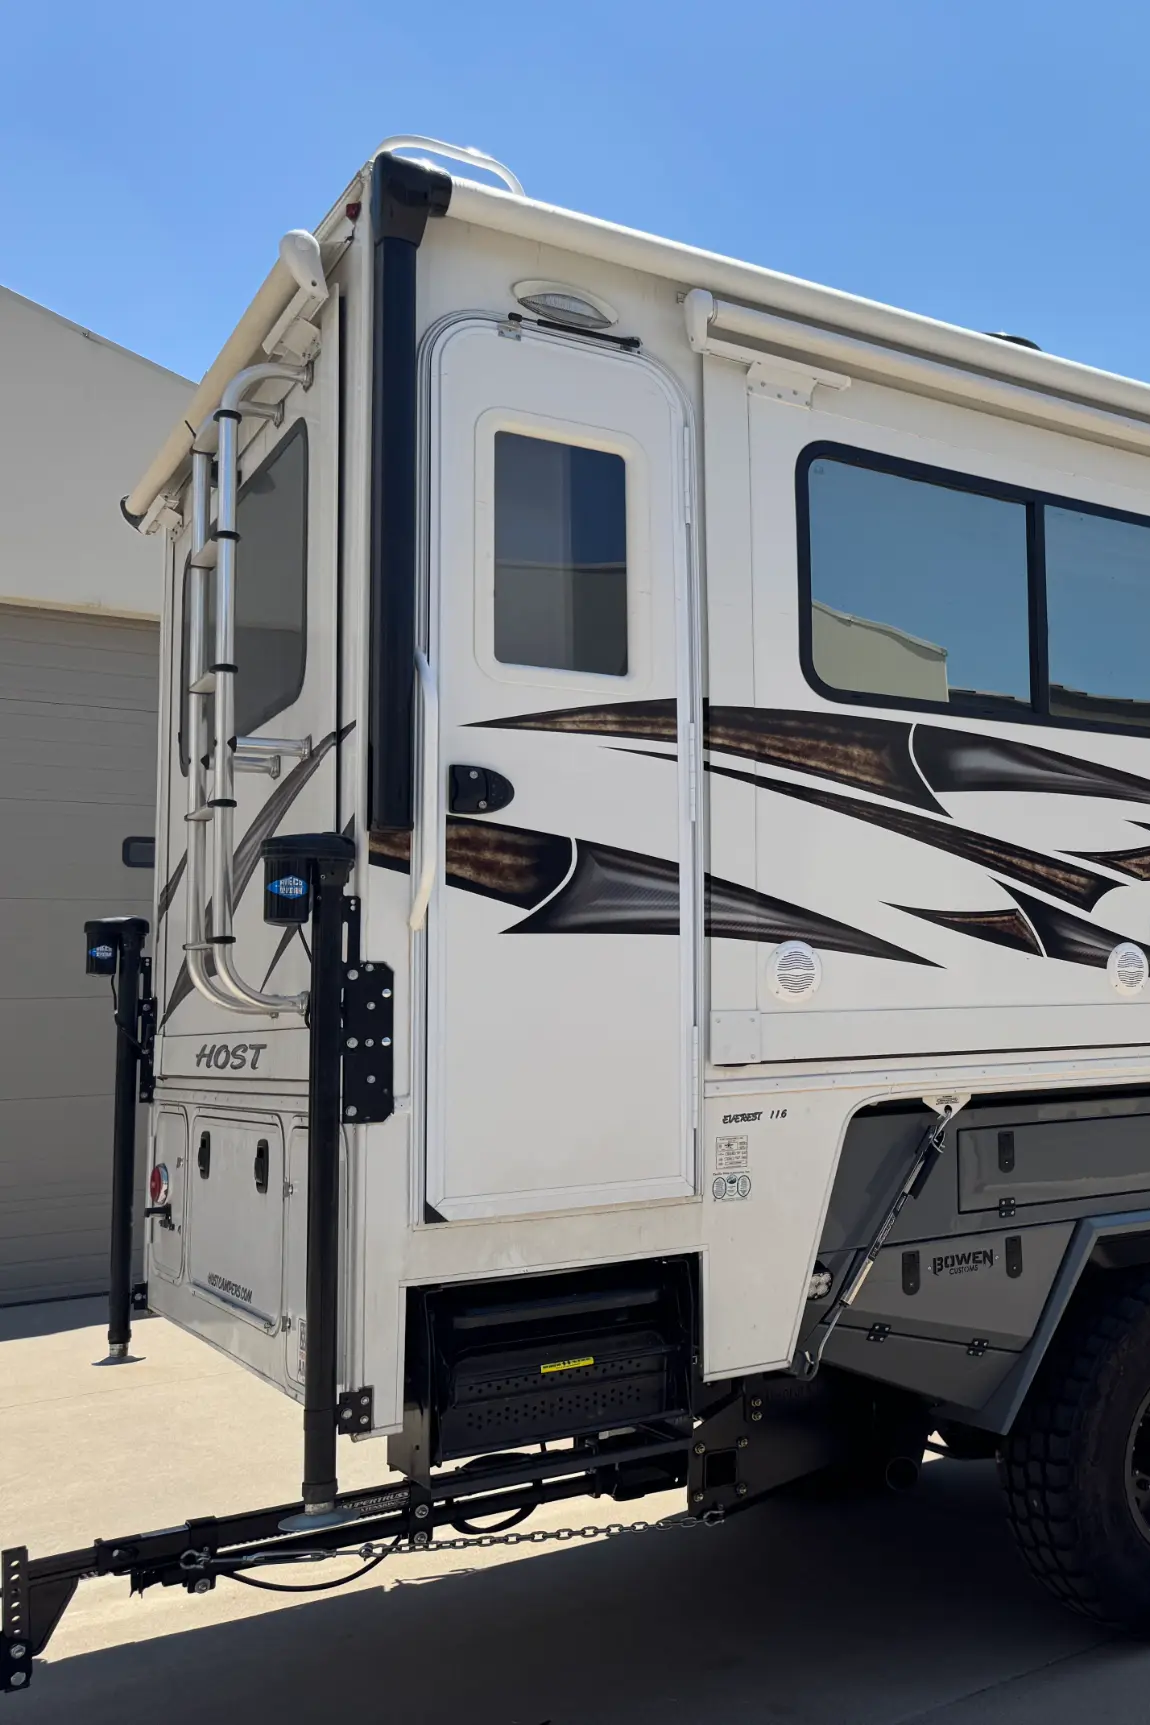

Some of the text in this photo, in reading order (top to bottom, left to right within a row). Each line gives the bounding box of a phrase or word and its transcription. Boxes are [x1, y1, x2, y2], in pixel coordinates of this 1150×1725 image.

[195, 1043, 268, 1071] HOST
[722, 1108, 788, 1125] EVEREST 116
[932, 1248, 994, 1277] BOWEN
[948, 1264, 979, 1276] CUSTOMS
